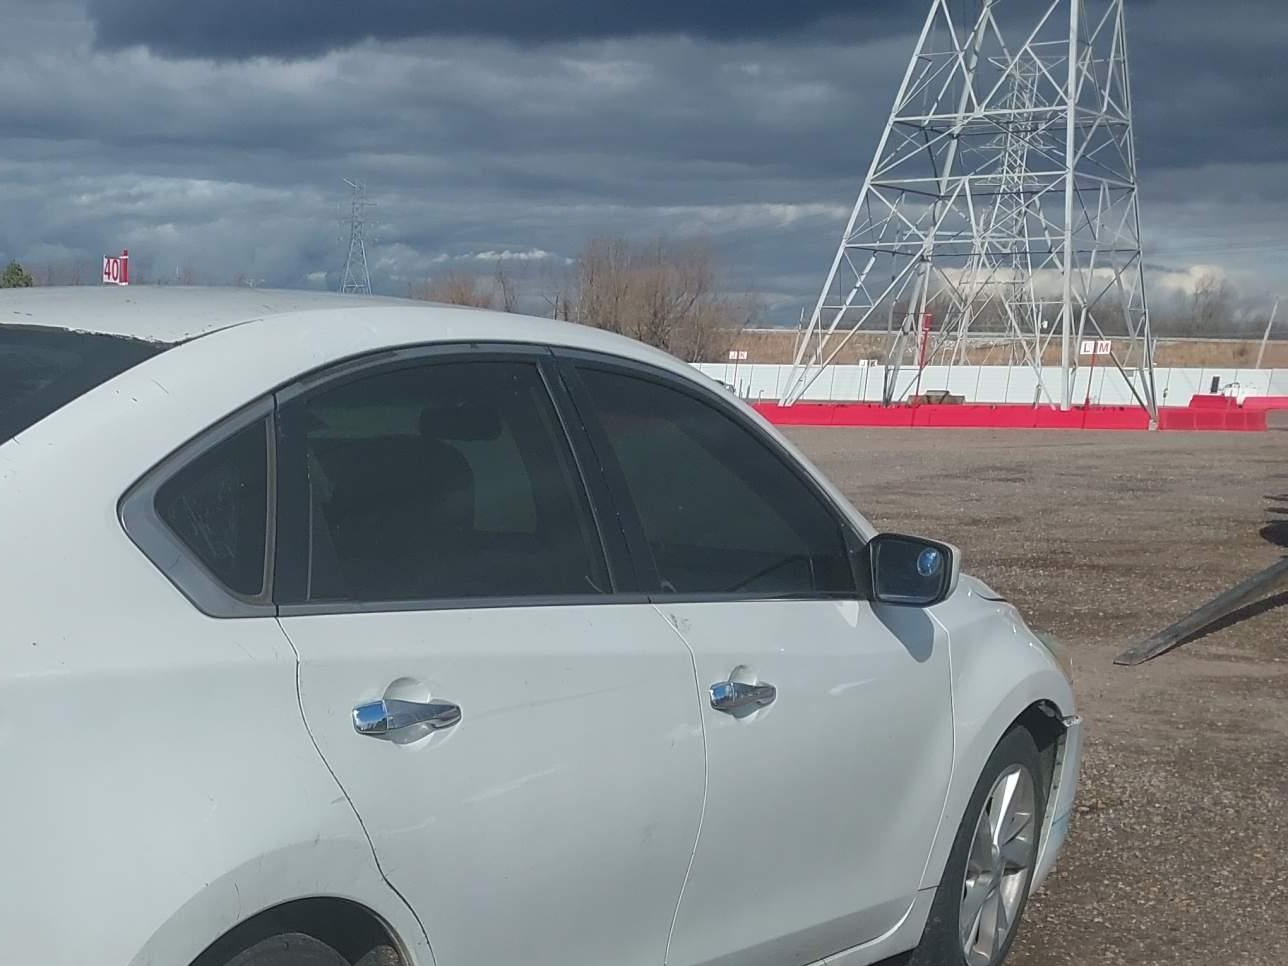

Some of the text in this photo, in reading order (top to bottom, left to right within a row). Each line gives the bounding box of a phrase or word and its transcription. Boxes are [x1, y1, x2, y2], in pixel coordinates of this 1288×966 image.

[104, 258, 119, 281] 40
[1083, 342, 1110, 353] L M
